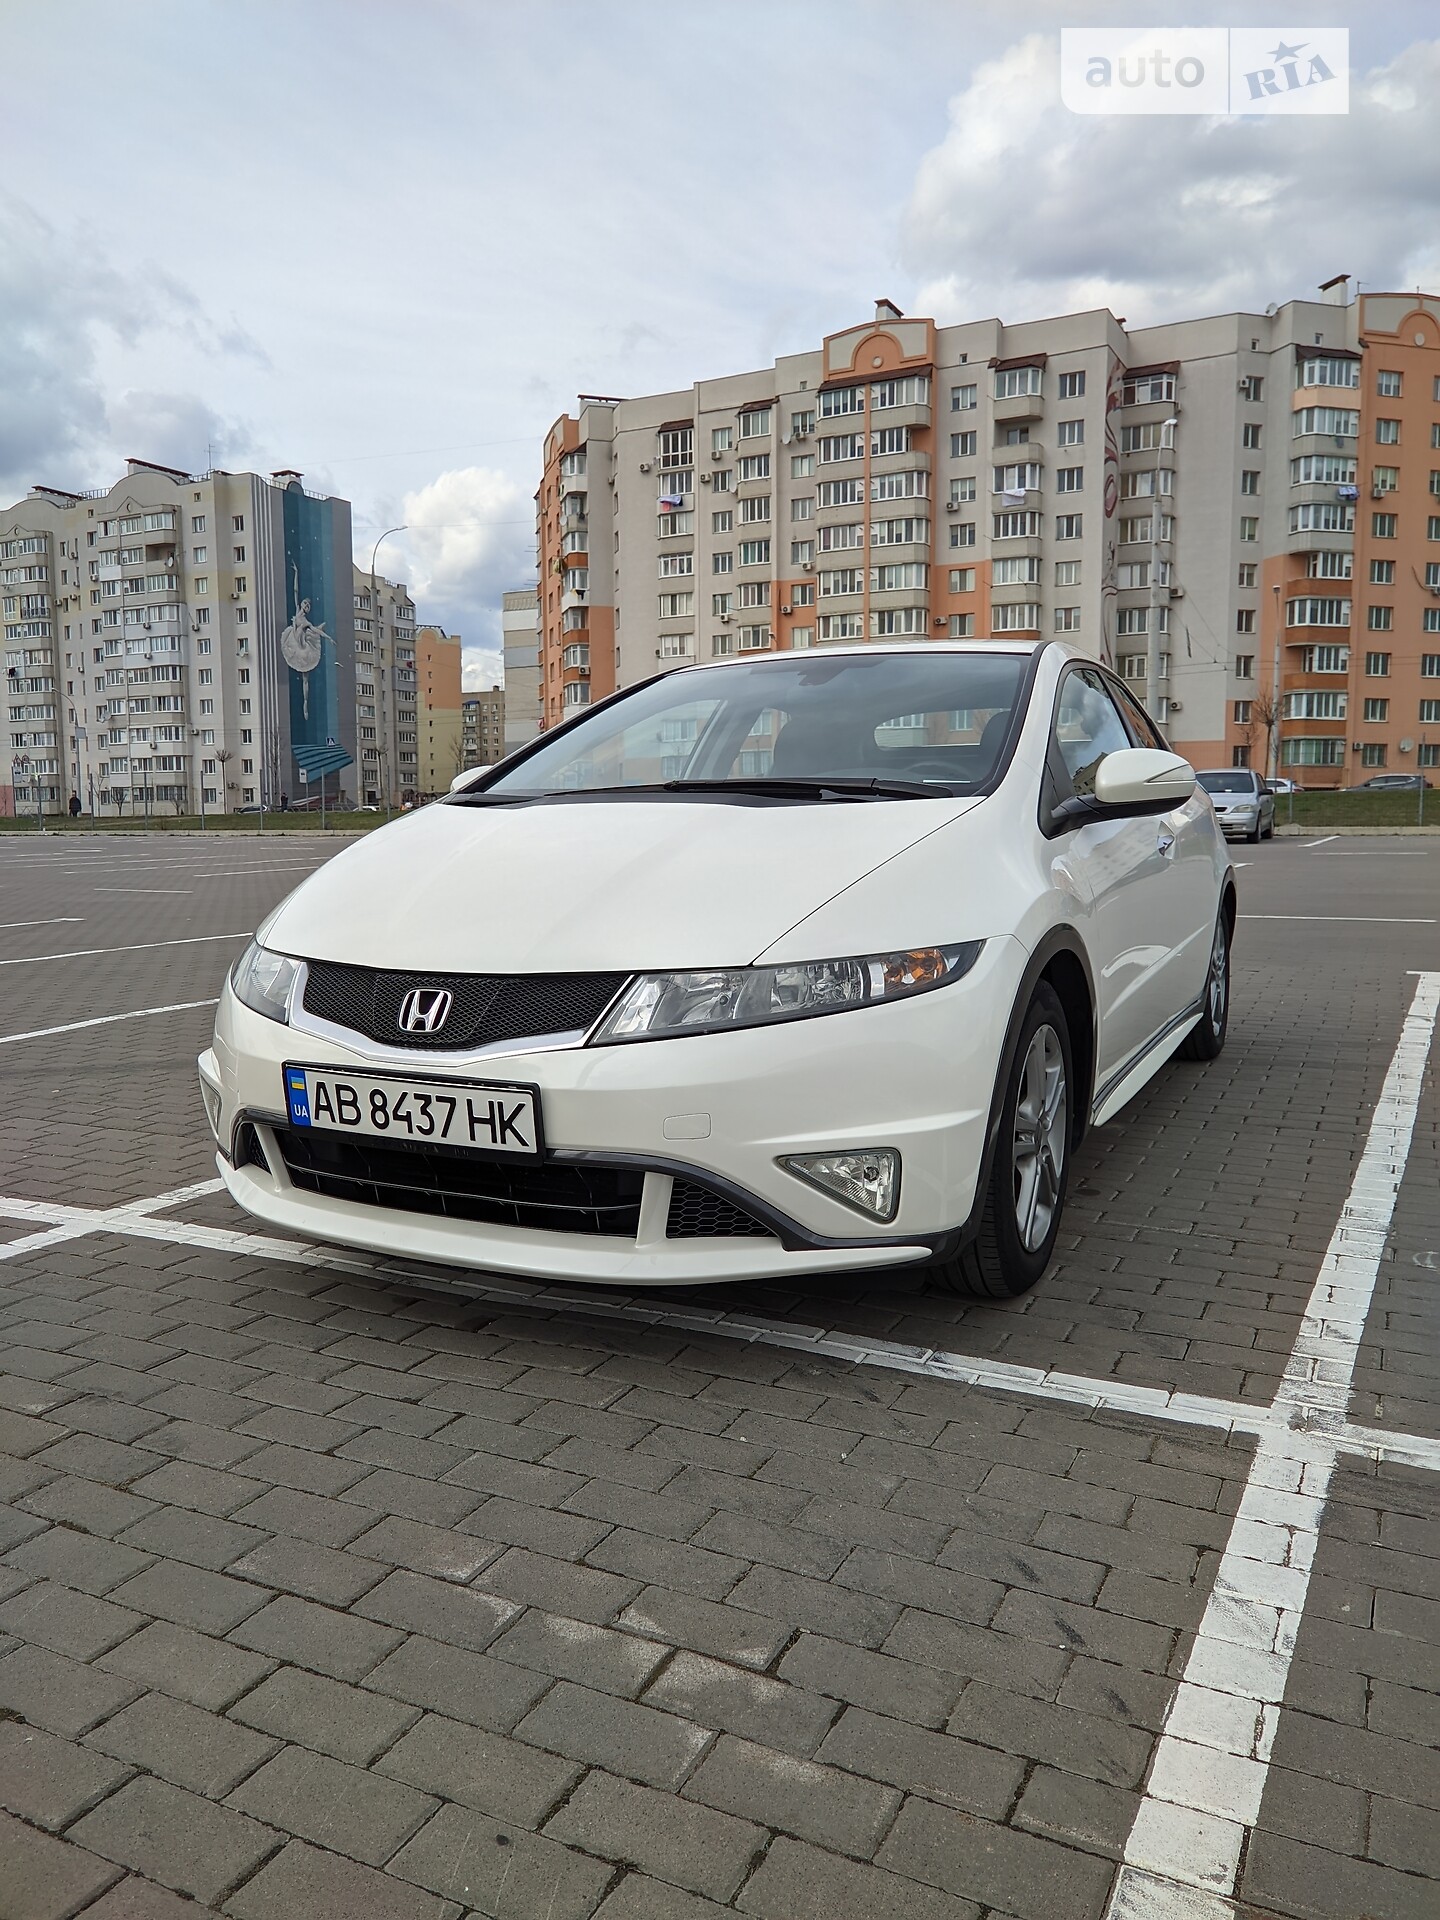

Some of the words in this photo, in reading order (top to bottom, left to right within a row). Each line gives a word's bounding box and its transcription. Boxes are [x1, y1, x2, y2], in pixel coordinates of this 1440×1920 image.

[294, 1104, 308, 1118] UA
[314, 1081, 362, 1125] AB
[369, 1088, 457, 1138] 8437
[466, 1098, 529, 1147] HK
